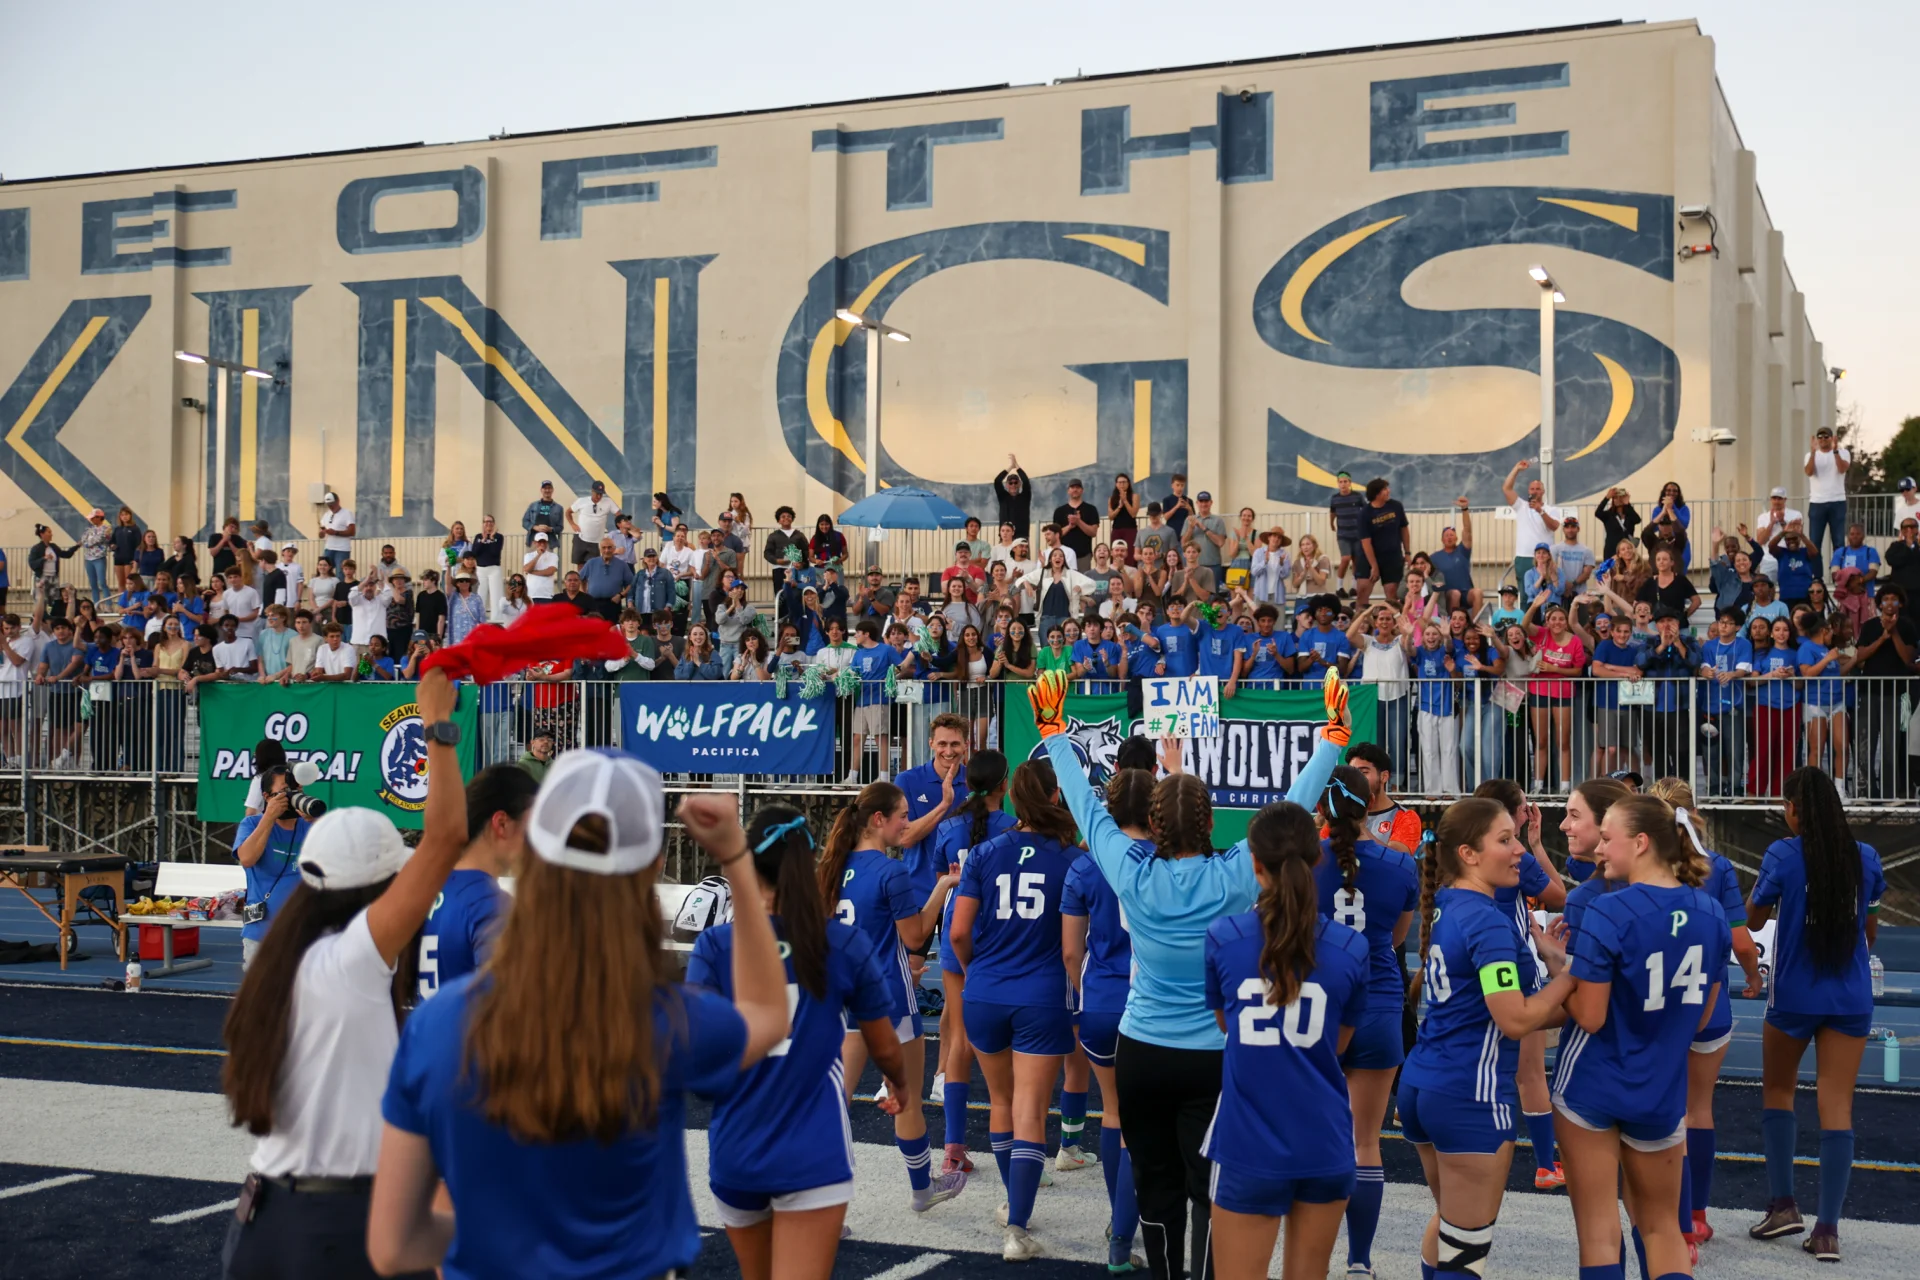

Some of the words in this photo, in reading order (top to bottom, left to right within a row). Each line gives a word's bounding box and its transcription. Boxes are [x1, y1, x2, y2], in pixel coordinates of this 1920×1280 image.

[0, 189, 237, 280] E
[336, 146, 717, 254] OF
[812, 62, 1570, 211] THE
[904, 686, 914, 696] D
[1150, 681, 1171, 706] I
[1176, 680, 1213, 706] AM
[1632, 684, 1641, 696] E
[1200, 701, 1219, 714] #1
[264, 712, 309, 743] GO
[1190, 712, 1218, 737] FAN
[692, 747, 760, 757] PACIFICA
[1018, 846, 1035, 865] P
[842, 868, 855, 888] P
[996, 872, 1045, 919] 15
[1334, 888, 1366, 932] 8
[1670, 910, 1688, 937] P
[418, 935, 439, 1001] 5
[1496, 967, 1513, 988] C
[1644, 944, 1707, 1011] 14
[1237, 978, 1327, 1049] 20
